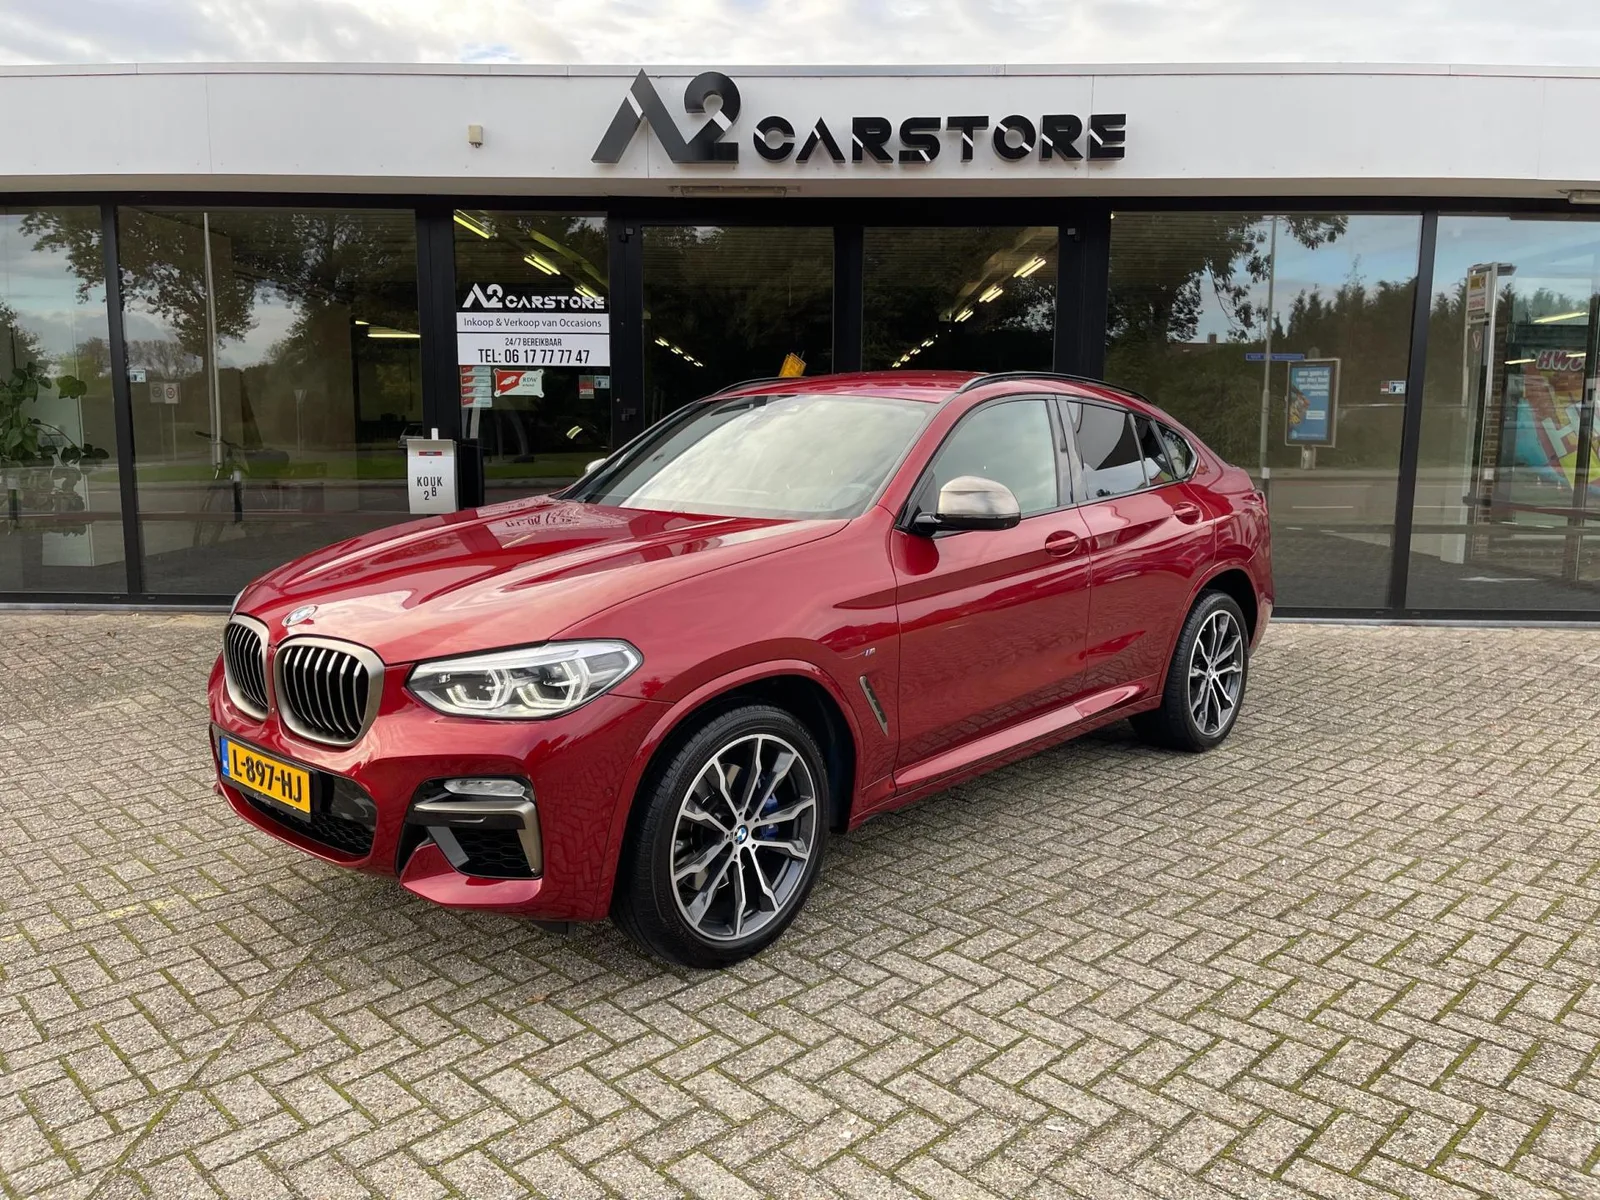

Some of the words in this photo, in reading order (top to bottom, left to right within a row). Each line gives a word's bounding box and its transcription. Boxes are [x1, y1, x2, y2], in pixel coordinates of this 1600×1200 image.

[592, 68, 741, 164] A2
[753, 114, 1127, 164] CARSTORE
[462, 283, 503, 309] A2
[505, 295, 605, 309] CARSTORE
[463, 317, 494, 328] Inkoop
[495, 317, 503, 327] &
[504, 317, 540, 328] Verkoop
[542, 319, 559, 327] van
[560, 317, 602, 328] Occasions
[505, 338, 521, 347] 24/7
[522, 338, 562, 347] BEREIKBAAR
[478, 349, 502, 364] TEL:
[504, 349, 519, 363] 06
[524, 350, 537, 364] 17
[540, 350, 554, 364] 77
[557, 350, 572, 364] 77
[575, 350, 590, 364] 47
[417, 476, 443, 486] KOUK
[232, 749, 302, 803] L-897-HJ
